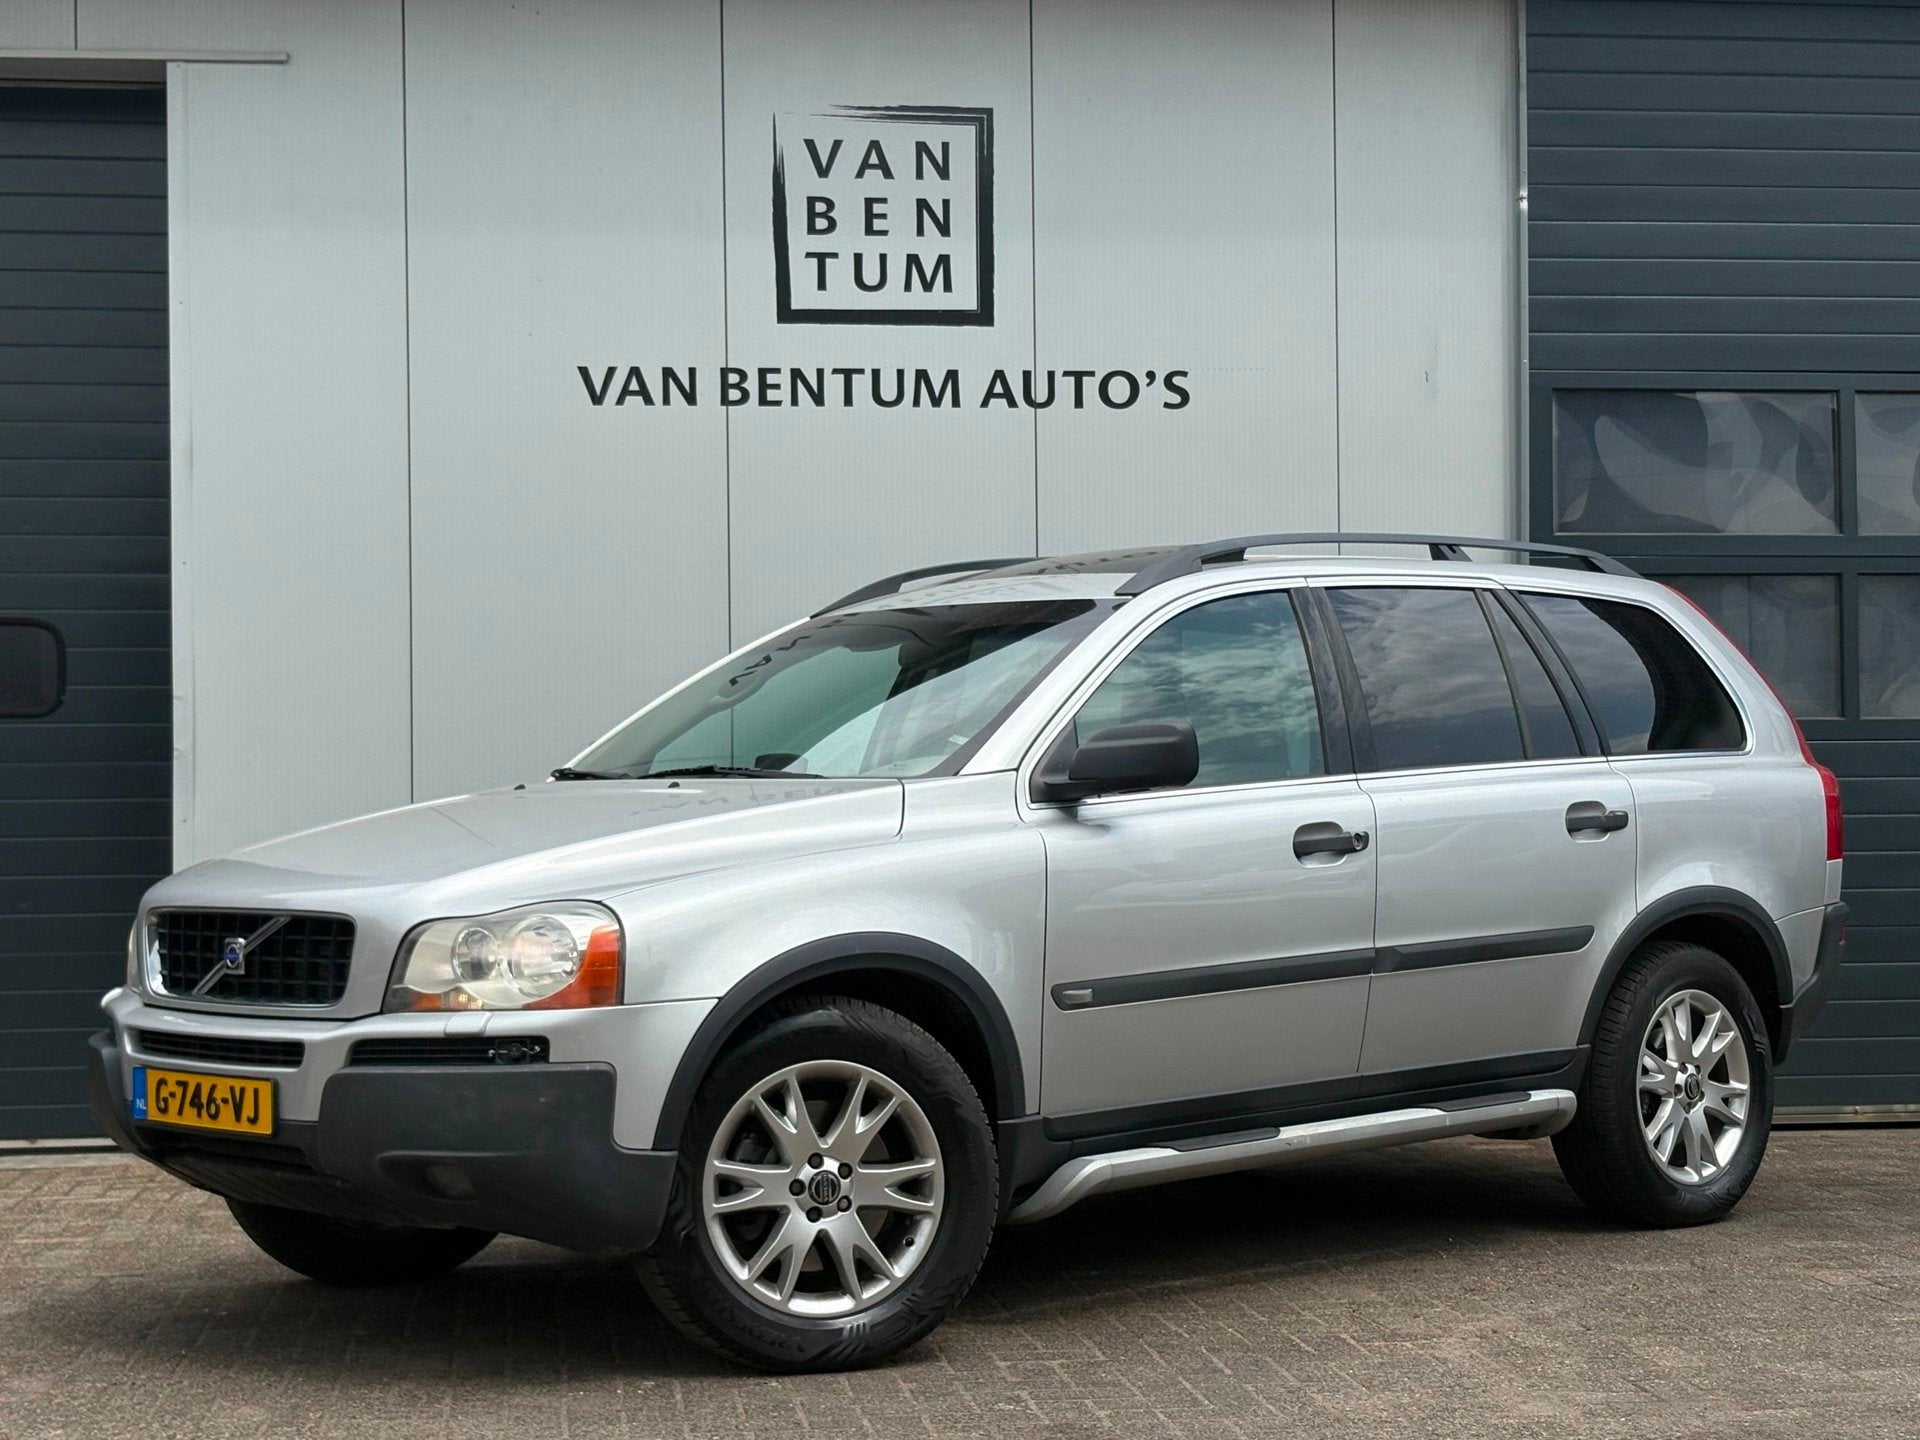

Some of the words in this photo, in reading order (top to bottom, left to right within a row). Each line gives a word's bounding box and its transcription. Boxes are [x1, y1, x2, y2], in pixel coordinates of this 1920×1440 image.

[803, 138, 951, 181] VAN
[806, 195, 951, 238] BEN
[804, 251, 953, 293] TUM
[577, 366, 698, 407] VAN
[719, 366, 961, 409] BENTUM
[979, 368, 1191, 410] AUTO'S
[136, 1098, 147, 1110] NL
[155, 1077, 259, 1125] G-746-VJ
